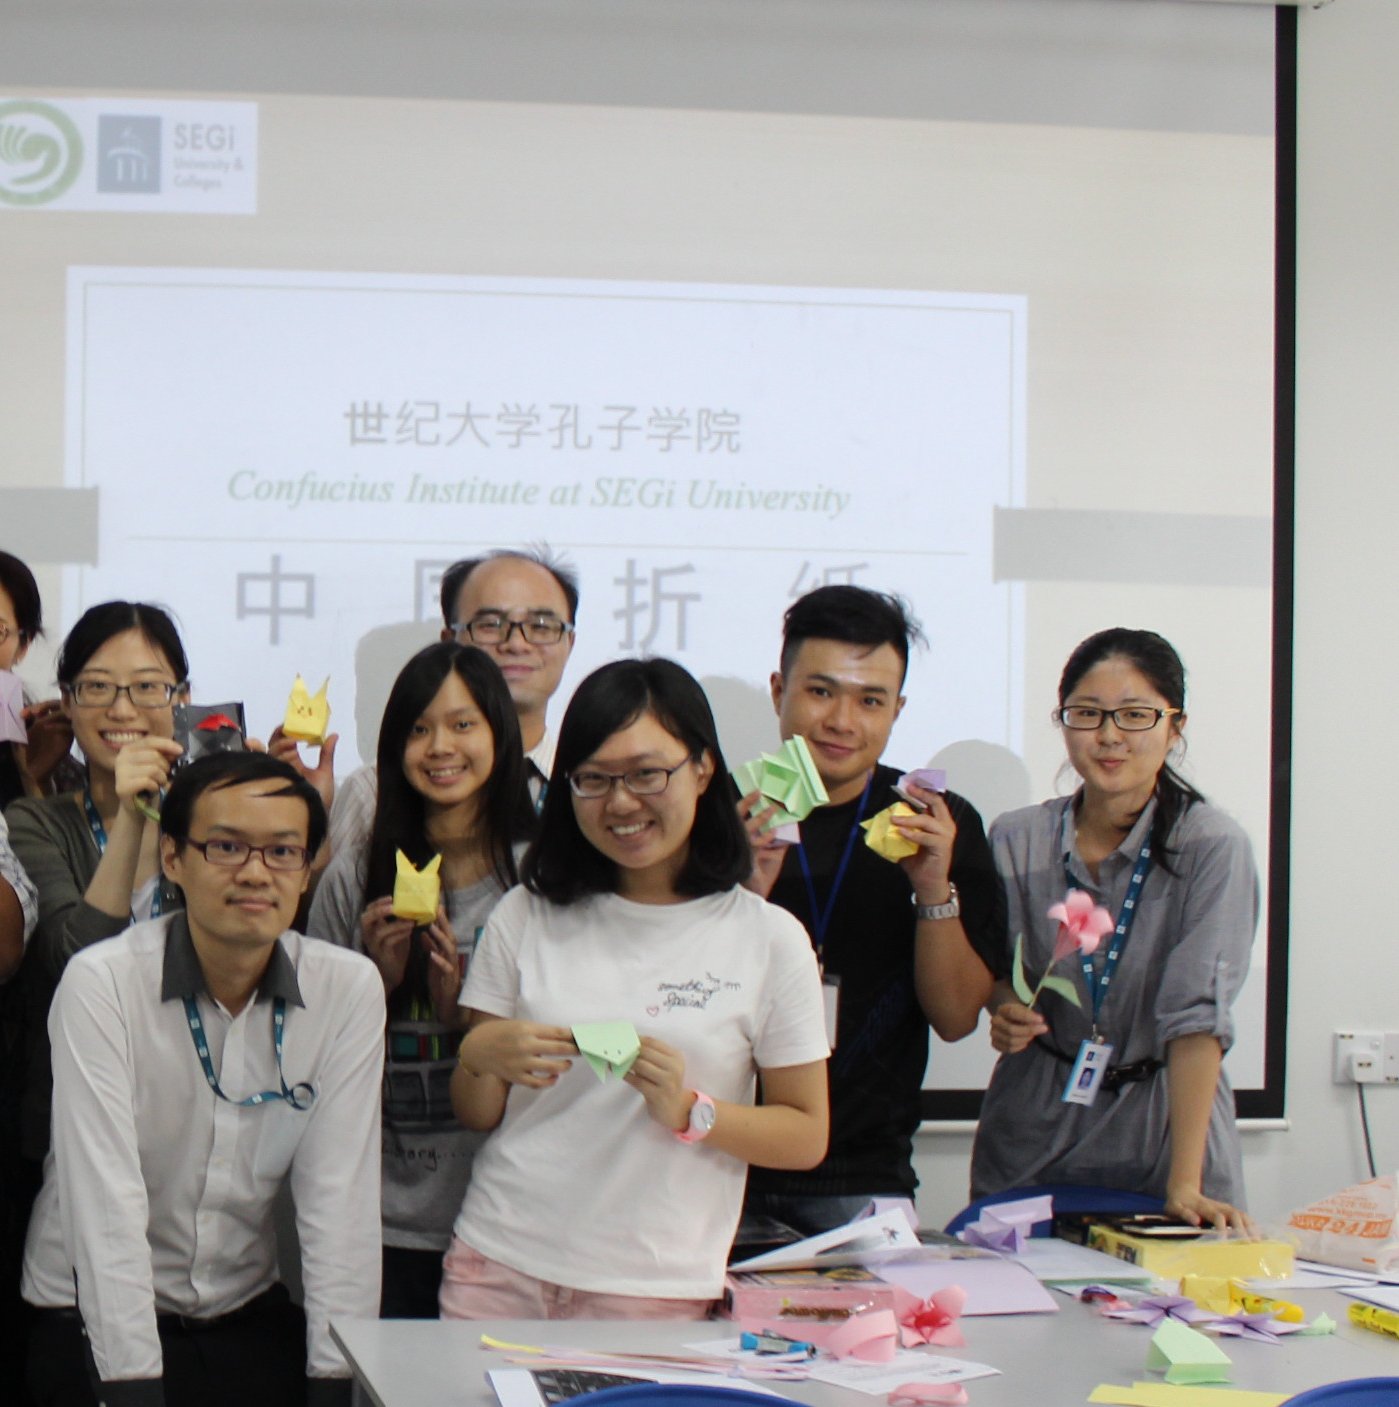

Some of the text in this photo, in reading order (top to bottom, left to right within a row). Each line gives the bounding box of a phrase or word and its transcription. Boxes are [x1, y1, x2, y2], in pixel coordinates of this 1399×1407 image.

[174, 122, 234, 152] SEGi
[343, 400, 742, 454] 世纪大学孔子学院
[227, 469, 851, 521] Confucius Institute at SEGi University
